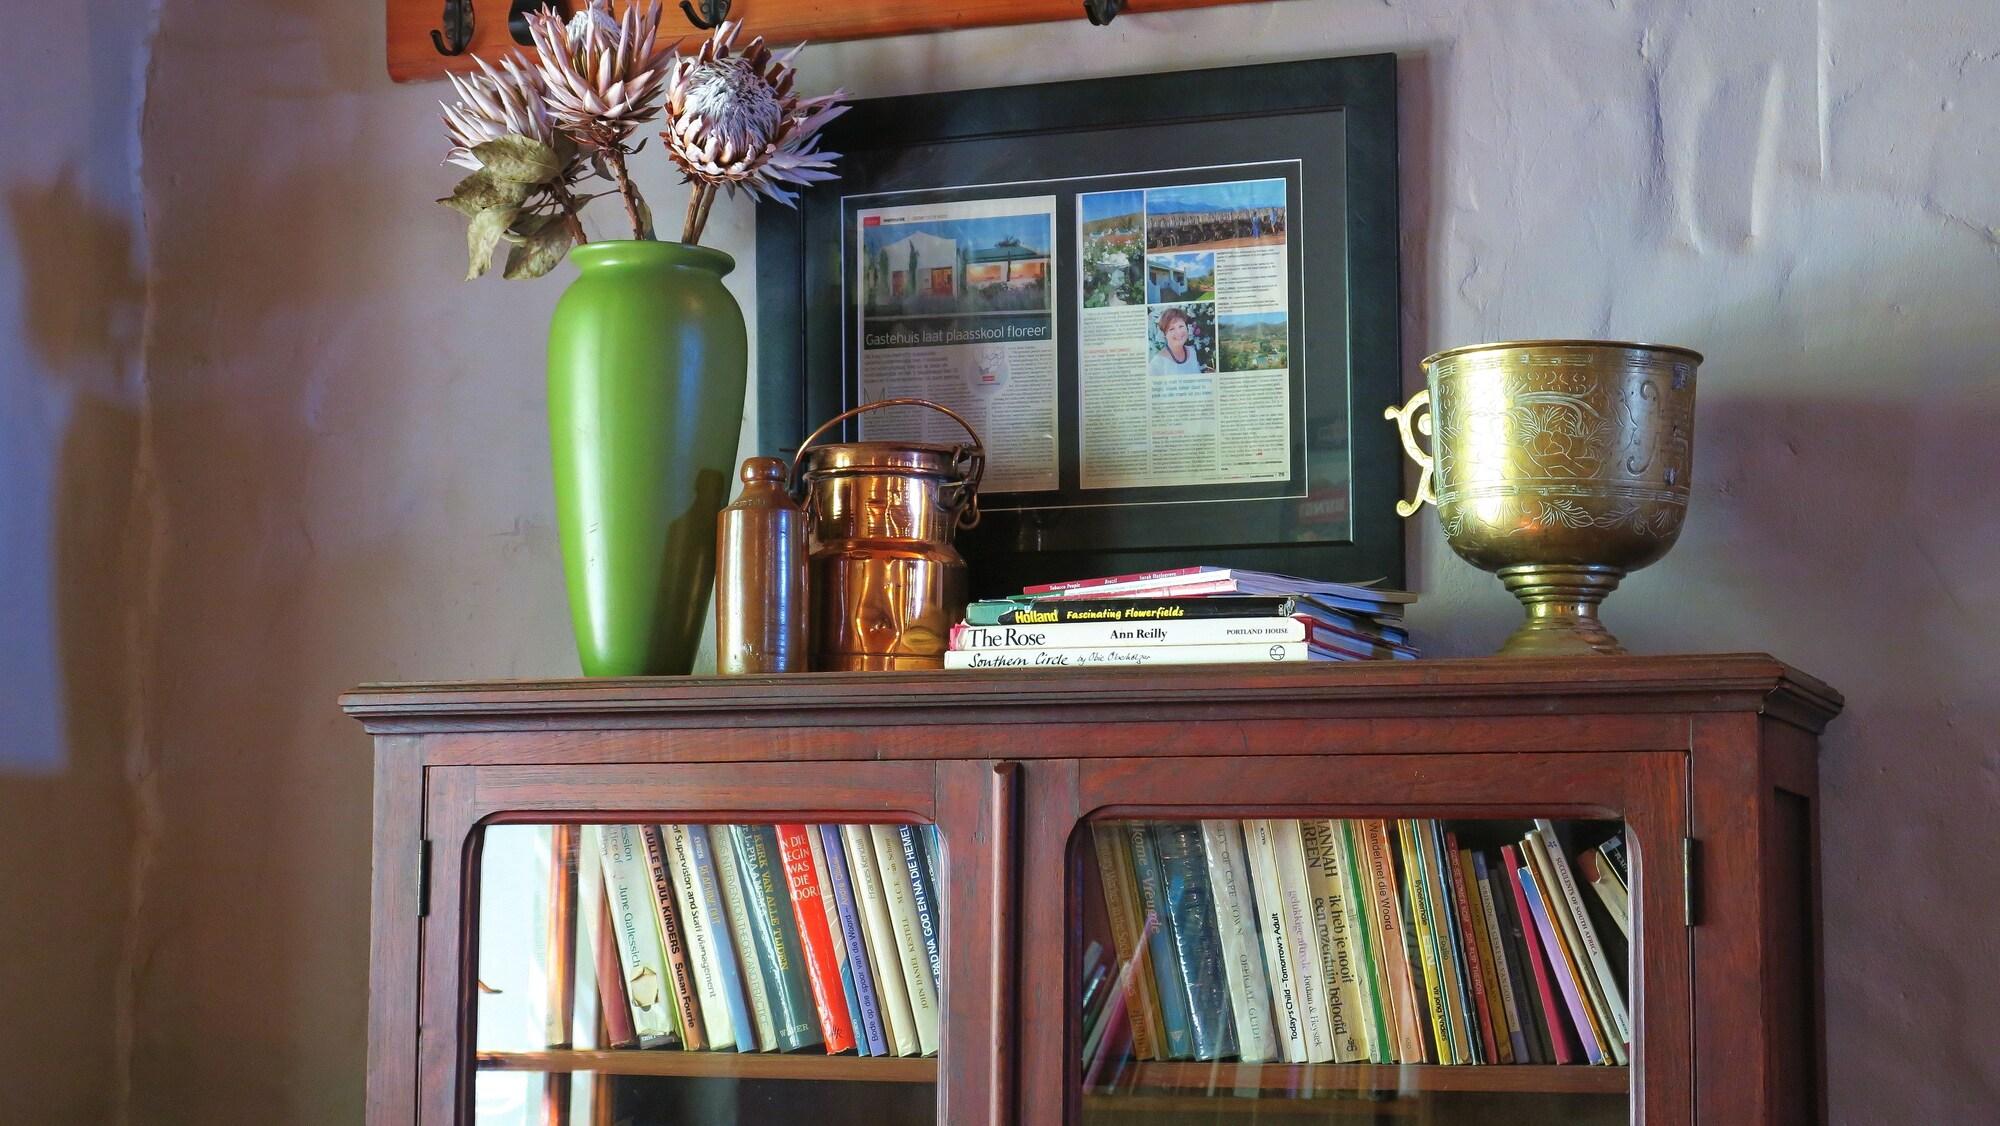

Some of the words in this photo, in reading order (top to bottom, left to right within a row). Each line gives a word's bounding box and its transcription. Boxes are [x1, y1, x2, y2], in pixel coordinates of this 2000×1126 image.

[865, 332, 920, 346] Gastehuis
[922, 330, 944, 342] laat
[946, 327, 1004, 344] plaasskool
[1007, 325, 1047, 338] floreer
[1015, 609, 1059, 624] Holland
[1066, 609, 1122, 621] Fascinating
[1125, 606, 1184, 618] Flowerfields
[968, 628, 1002, 647] The
[1005, 628, 1046, 646] Rose
[1110, 630, 1134, 640] Ann
[1136, 629, 1168, 642] Reilly
[968, 652, 1029, 668] Southern
[1034, 651, 1069, 666] Circle
[645, 830, 657, 864] JULLE
[751, 833, 768, 868] KERK
[790, 834, 806, 848] DIE
[899, 824, 915, 860] HEMEL
[1369, 822, 1382, 860] Wandel
[674, 834, 691, 890] Supervision
[784, 847, 810, 862] EGIN
[854, 838, 868, 868] Kendall
[653, 866, 663, 882] EN
[787, 861, 810, 874] WAS
[907, 860, 919, 878] DIE
[1375, 861, 1385, 880] met
[759, 871, 772, 893] VAN
[792, 874, 809, 887] DIE
[862, 868, 876, 899] Frances
[912, 879, 923, 895] NA
[1226, 870, 1237, 897] CAPE
[1378, 881, 1387, 896] die
[619, 884, 629, 910] June
[657, 884, 668, 904] JUL
[687, 891, 698, 910] and
[791, 884, 820, 901] OOR
[916, 896, 927, 911] EN
[1143, 868, 1162, 934] Vreugde
[1328, 895, 1341, 906] ik
[1415, 880, 1427, 925] Bybelverhale
[1569, 896, 1578, 906] OF
[765, 894, 780, 925] ALLE
[1315, 897, 1326, 921] een
[1381, 898, 1394, 930] Woord
[1573, 906, 1588, 929] SOUTH
[662, 906, 680, 954] KINDERS
[692, 911, 702, 932] Staff
[844, 914, 856, 940] Woord
[920, 913, 934, 939] GOD
[1272, 912, 1281, 935] Adult
[1331, 910, 1346, 934] heb
[850, 941, 859, 953] die
[926, 938, 937, 954] NA
[1334, 935, 1348, 948] je
[1582, 929, 1599, 956] AFRICA
[854, 954, 863, 969] van
[1276, 936, 1288, 983] Tomorrow's
[1318, 923, 1338, 985] rozentuin
[696, 933, 716, 998] Management
[910, 955, 923, 985] DANIEL
[1337, 951, 1352, 983] nooit
[675, 962, 687, 994] Susan
[857, 970, 869, 993] spoor
[861, 993, 871, 1007] die
[917, 988, 928, 1009] JOHN
[1283, 989, 1293, 1010] Child
[1304, 975, 1314, 1005] Jordaan
[683, 995, 695, 1028] Fourie
[866, 1008, 875, 1019] op
[1328, 987, 1348, 1035] beloofd
[1435, 996, 1443, 1014] jong
[779, 1023, 809, 1038] WER
[868, 1021, 879, 1041] Bode
[1286, 1010, 1298, 1041] Today's
[1438, 1015, 1447, 1041] kinders
